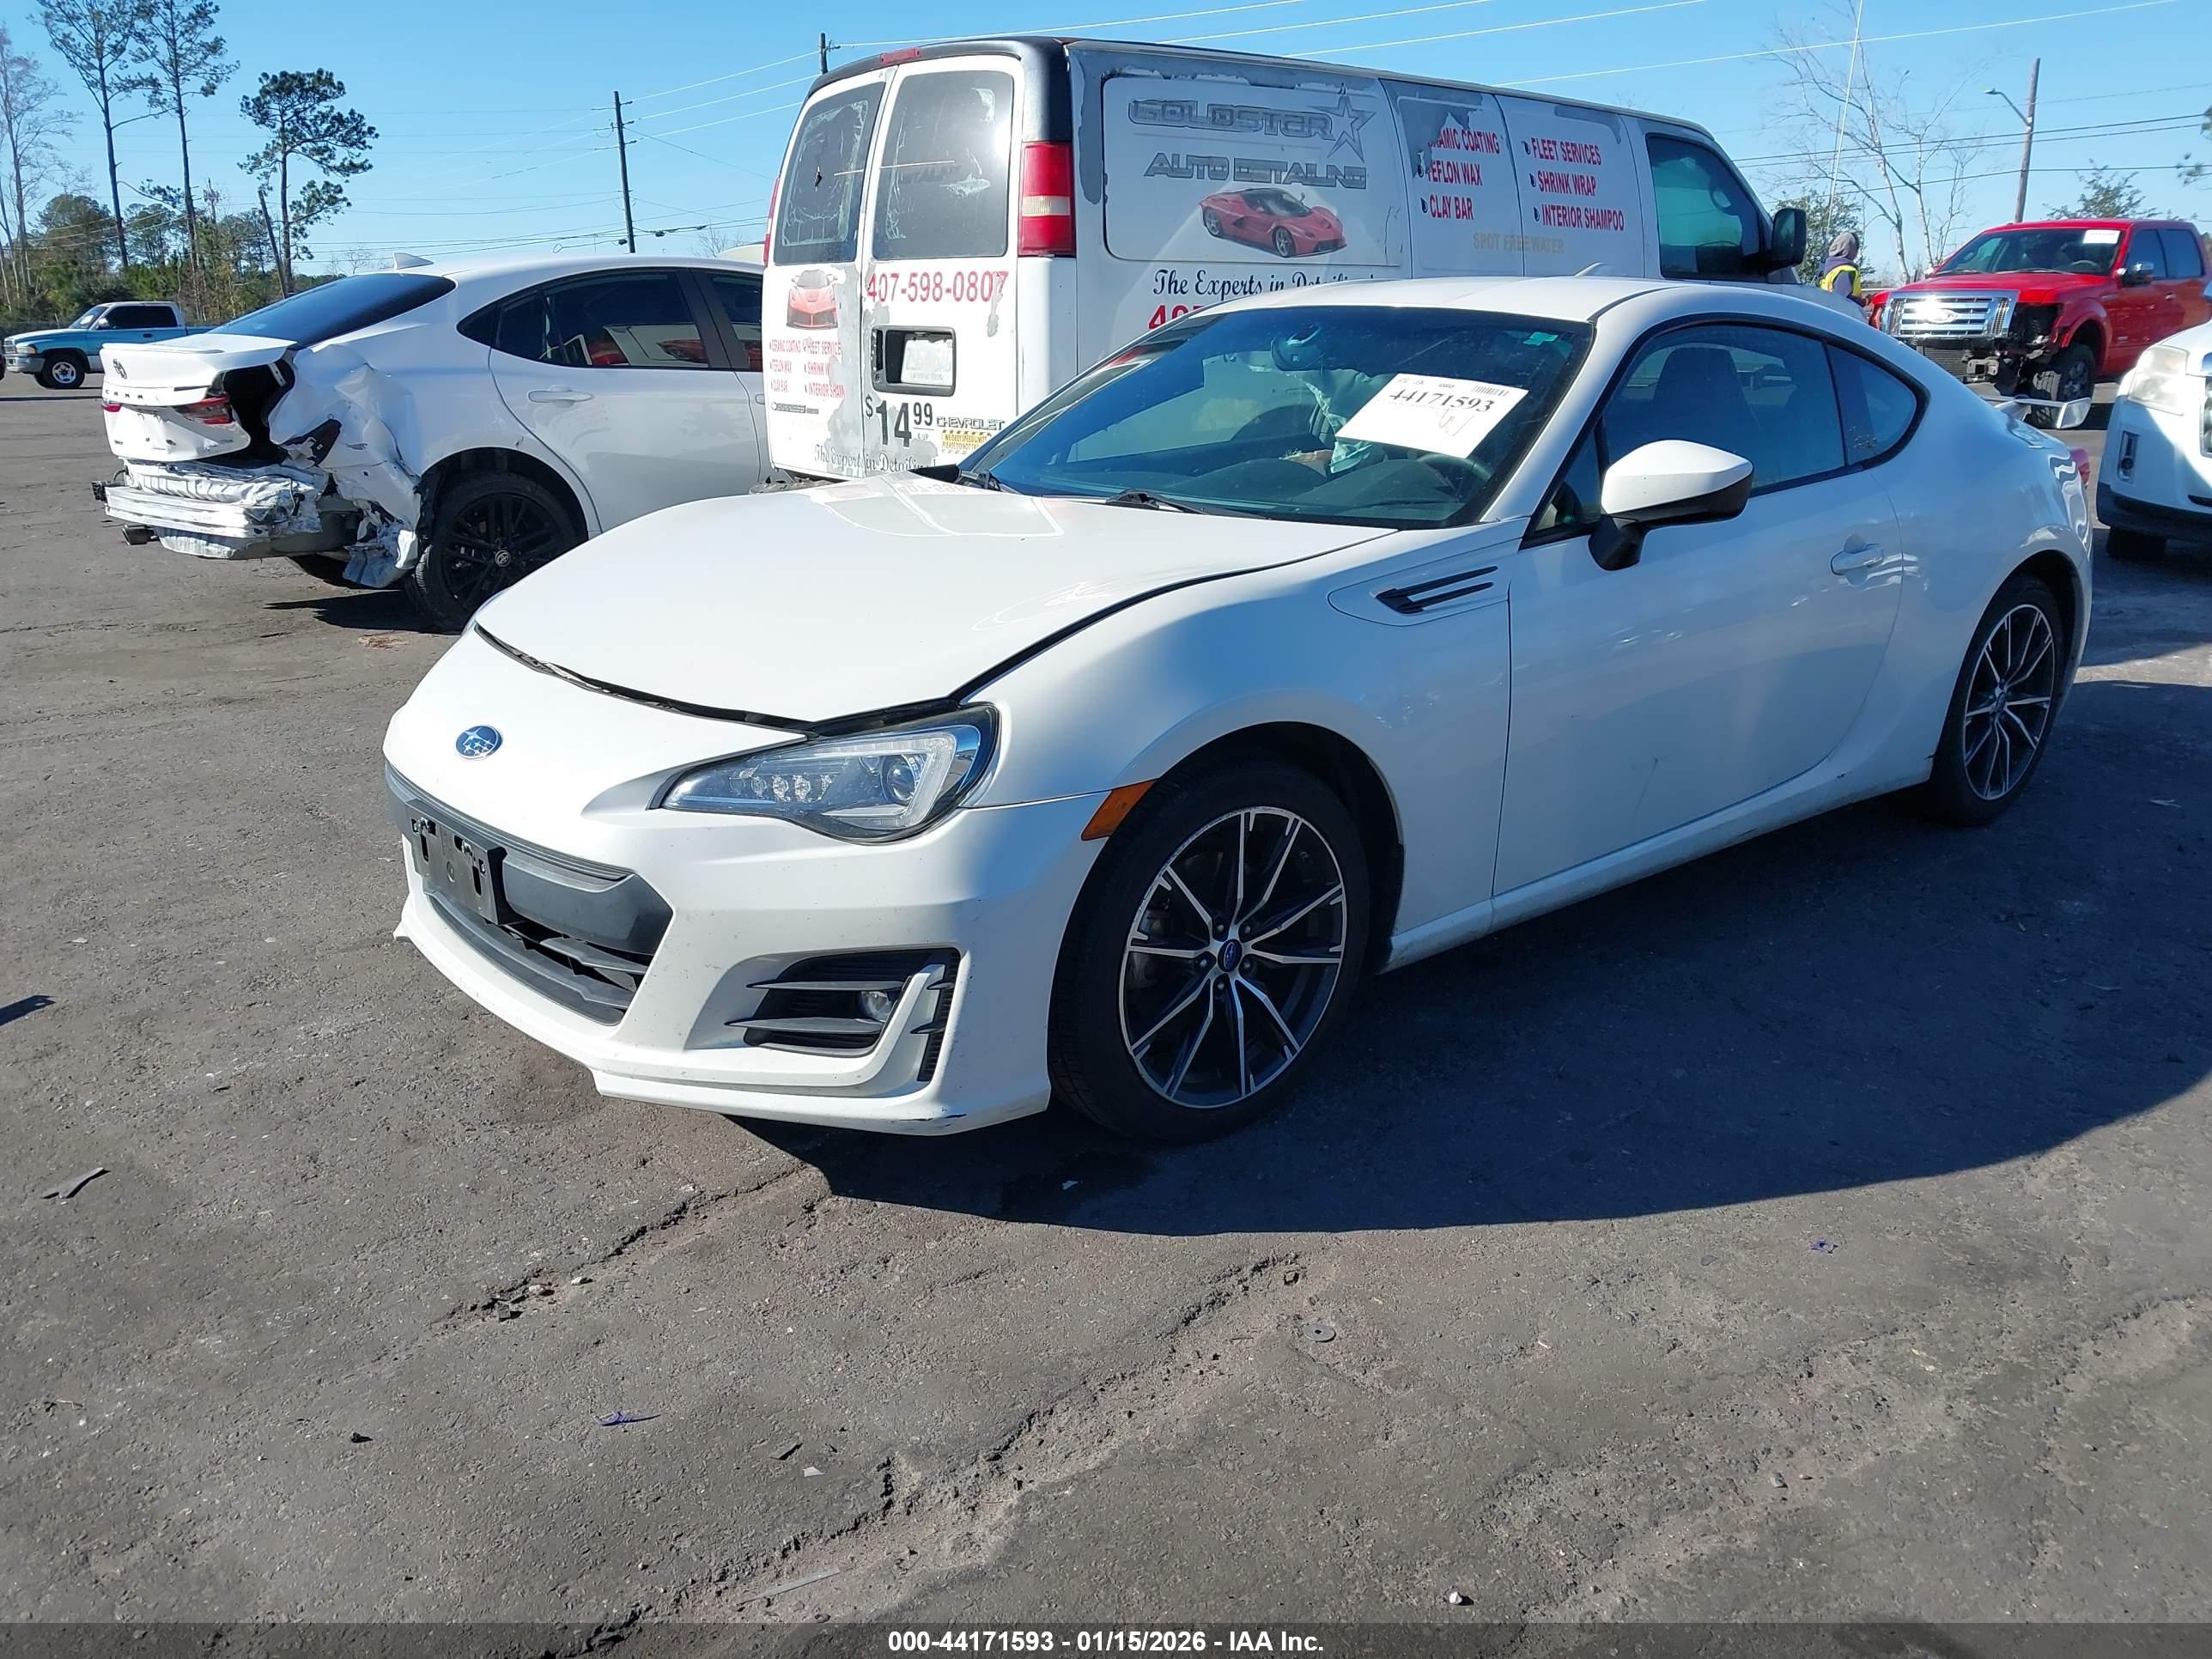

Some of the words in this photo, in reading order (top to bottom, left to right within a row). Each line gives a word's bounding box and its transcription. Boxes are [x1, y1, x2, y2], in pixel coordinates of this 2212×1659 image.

[1462, 129, 1501, 155] COATING
[1531, 137, 1559, 161] FLEET
[1559, 141, 1602, 166] SERVICES
[1144, 152, 1230, 180] AUTO
[1462, 162, 1483, 186] WAX
[1537, 170, 1572, 194] SHRINK
[1572, 174, 1596, 197] WRAP
[1430, 195, 1451, 219] CLAY
[1454, 197, 1474, 221] BAR
[1541, 204, 1583, 229] INTERIOR
[1584, 207, 1625, 232] SHAMPOO
[1473, 233, 1498, 250] SPOT
[866, 271, 1009, 302] 407-598-0807
[1153, 270, 1189, 295] The
[1195, 270, 1262, 301] Experts
[1269, 274, 1285, 292] in
[1389, 389, 1495, 412] 44171593
[936, 416, 1006, 431] CHEVROLET
[815, 443, 830, 464] The
